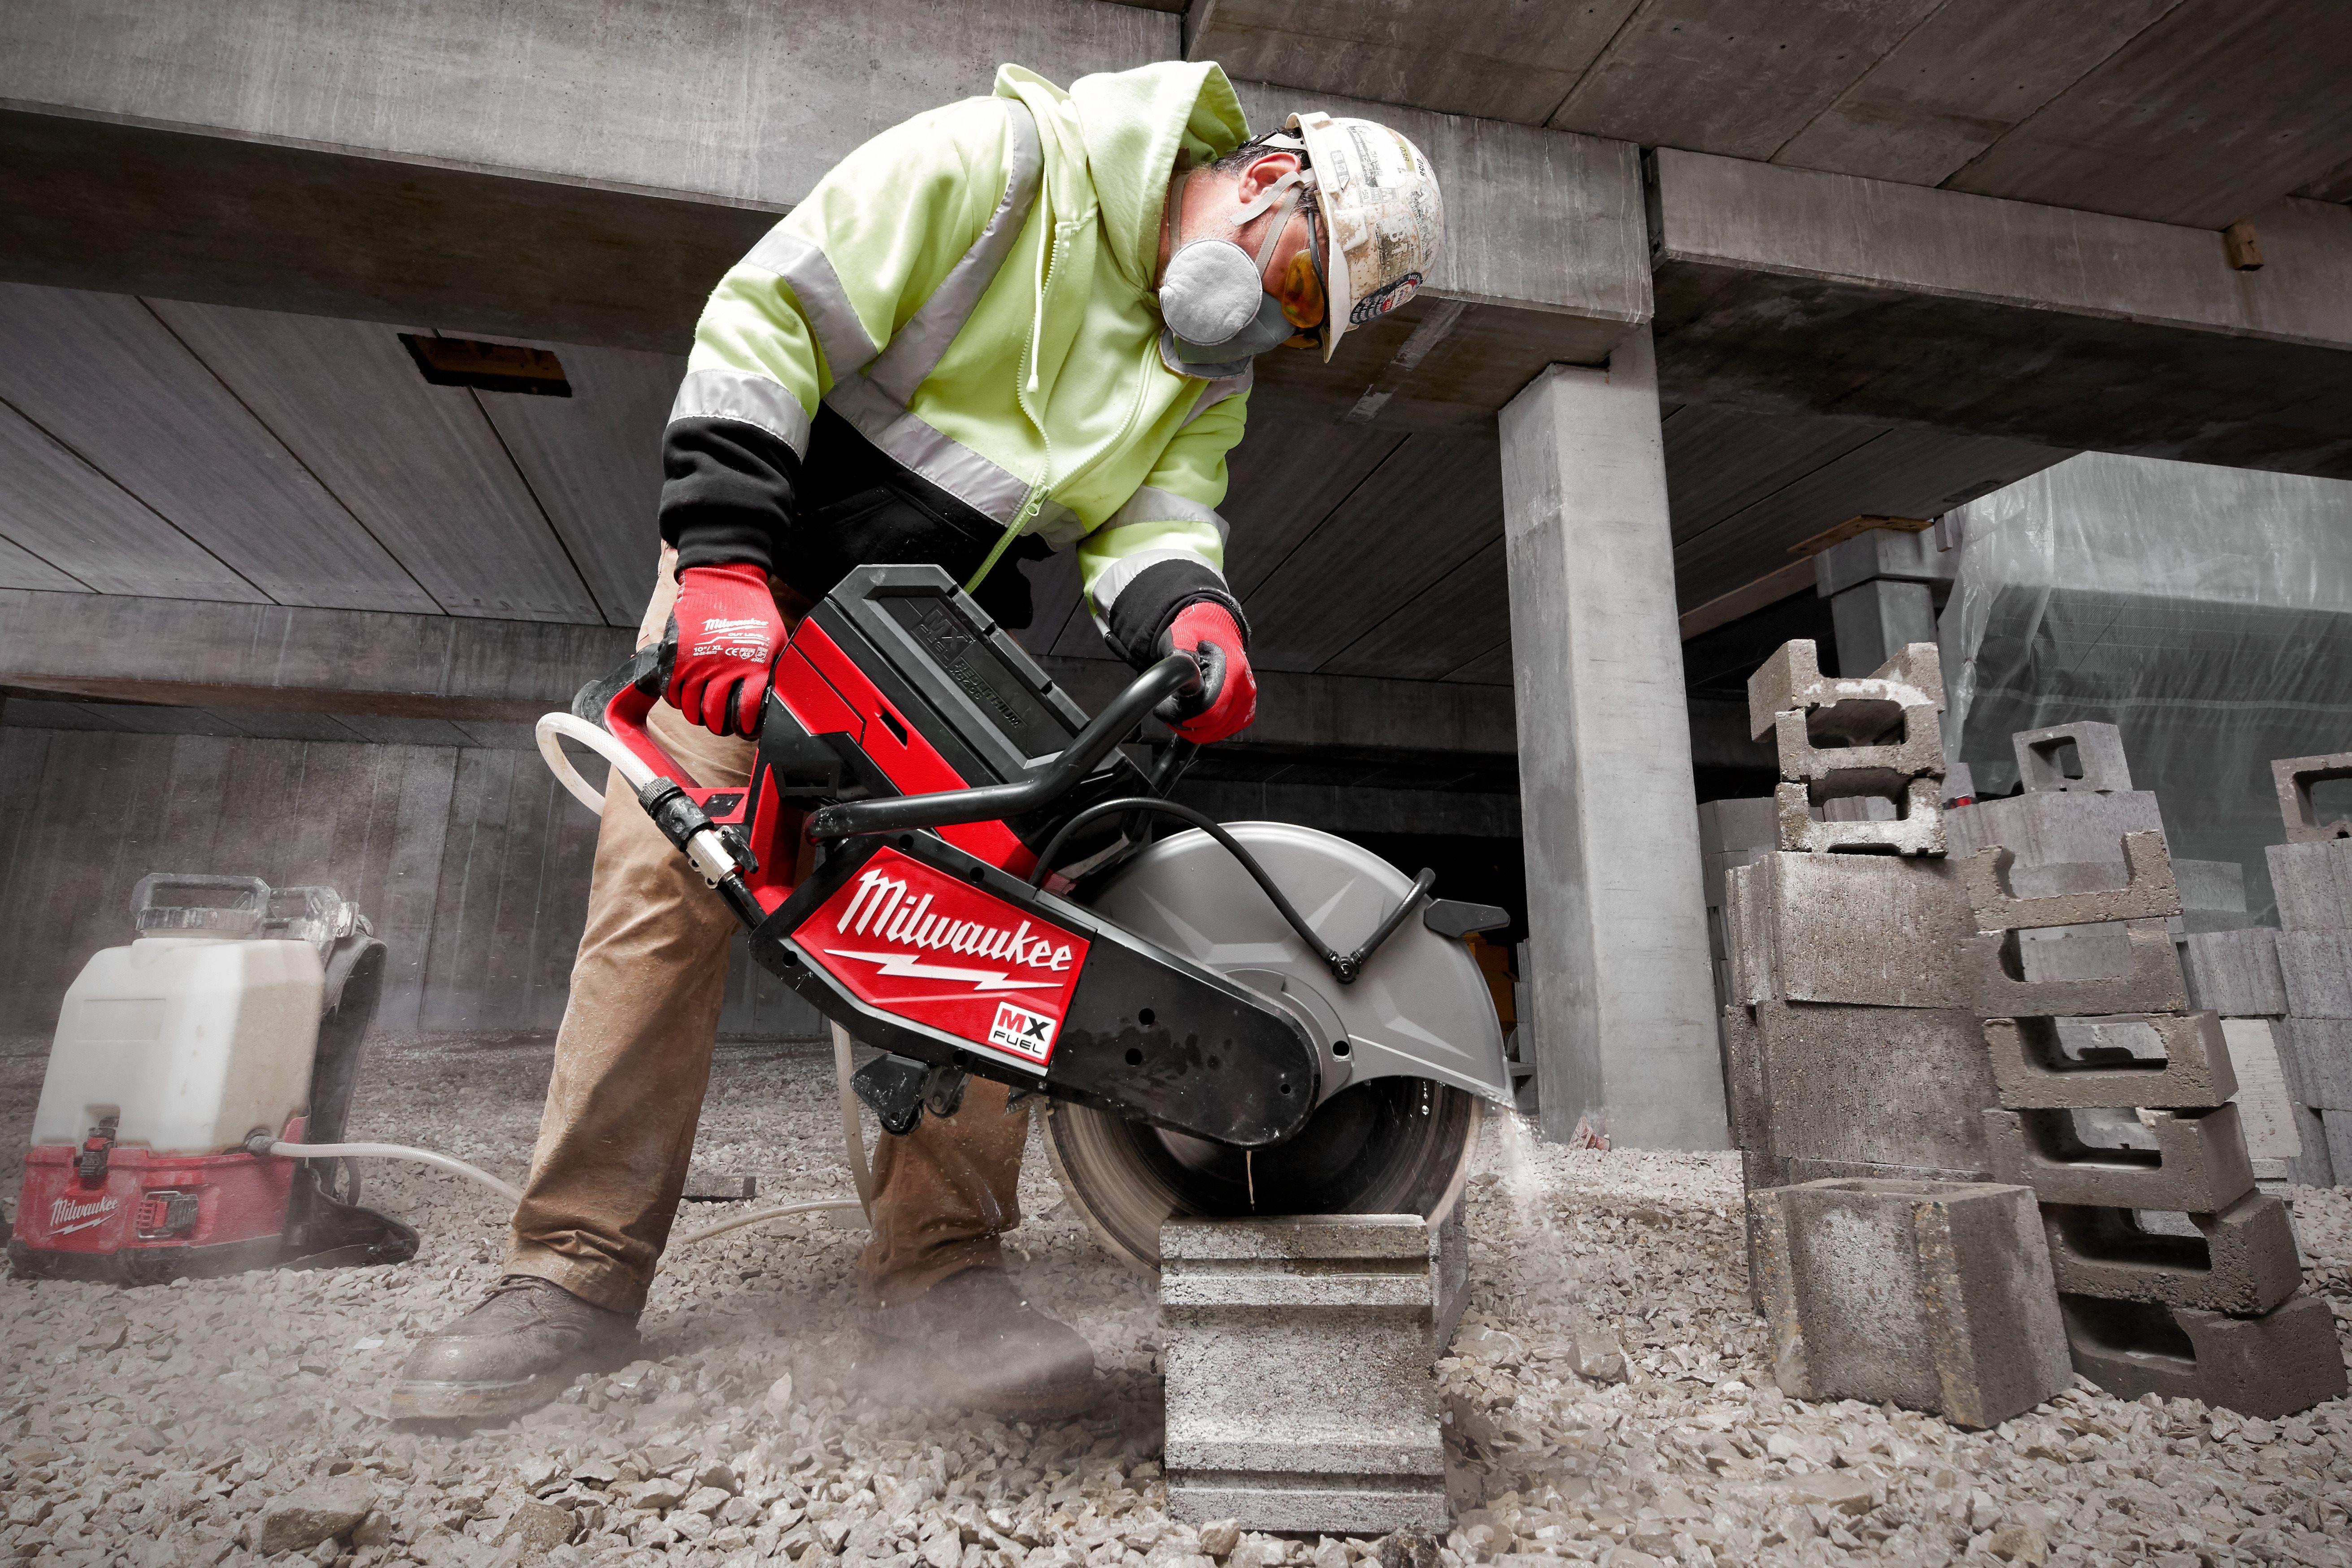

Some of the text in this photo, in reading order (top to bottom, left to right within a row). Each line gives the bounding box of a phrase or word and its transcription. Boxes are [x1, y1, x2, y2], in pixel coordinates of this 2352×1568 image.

[1399, 146, 1409, 162] 038
[701, 617, 769, 631] Milwaukee
[923, 608, 969, 654] MX
[725, 647, 740, 656] CE
[917, 624, 951, 662] FUEL
[954, 661, 1024, 729] REDLITHIUM
[837, 869, 1072, 971] Milwaukee
[997, 1008, 1050, 1042] MX
[993, 1030, 1042, 1055] FUEL
[50, 1196, 118, 1226] Milwaukee
